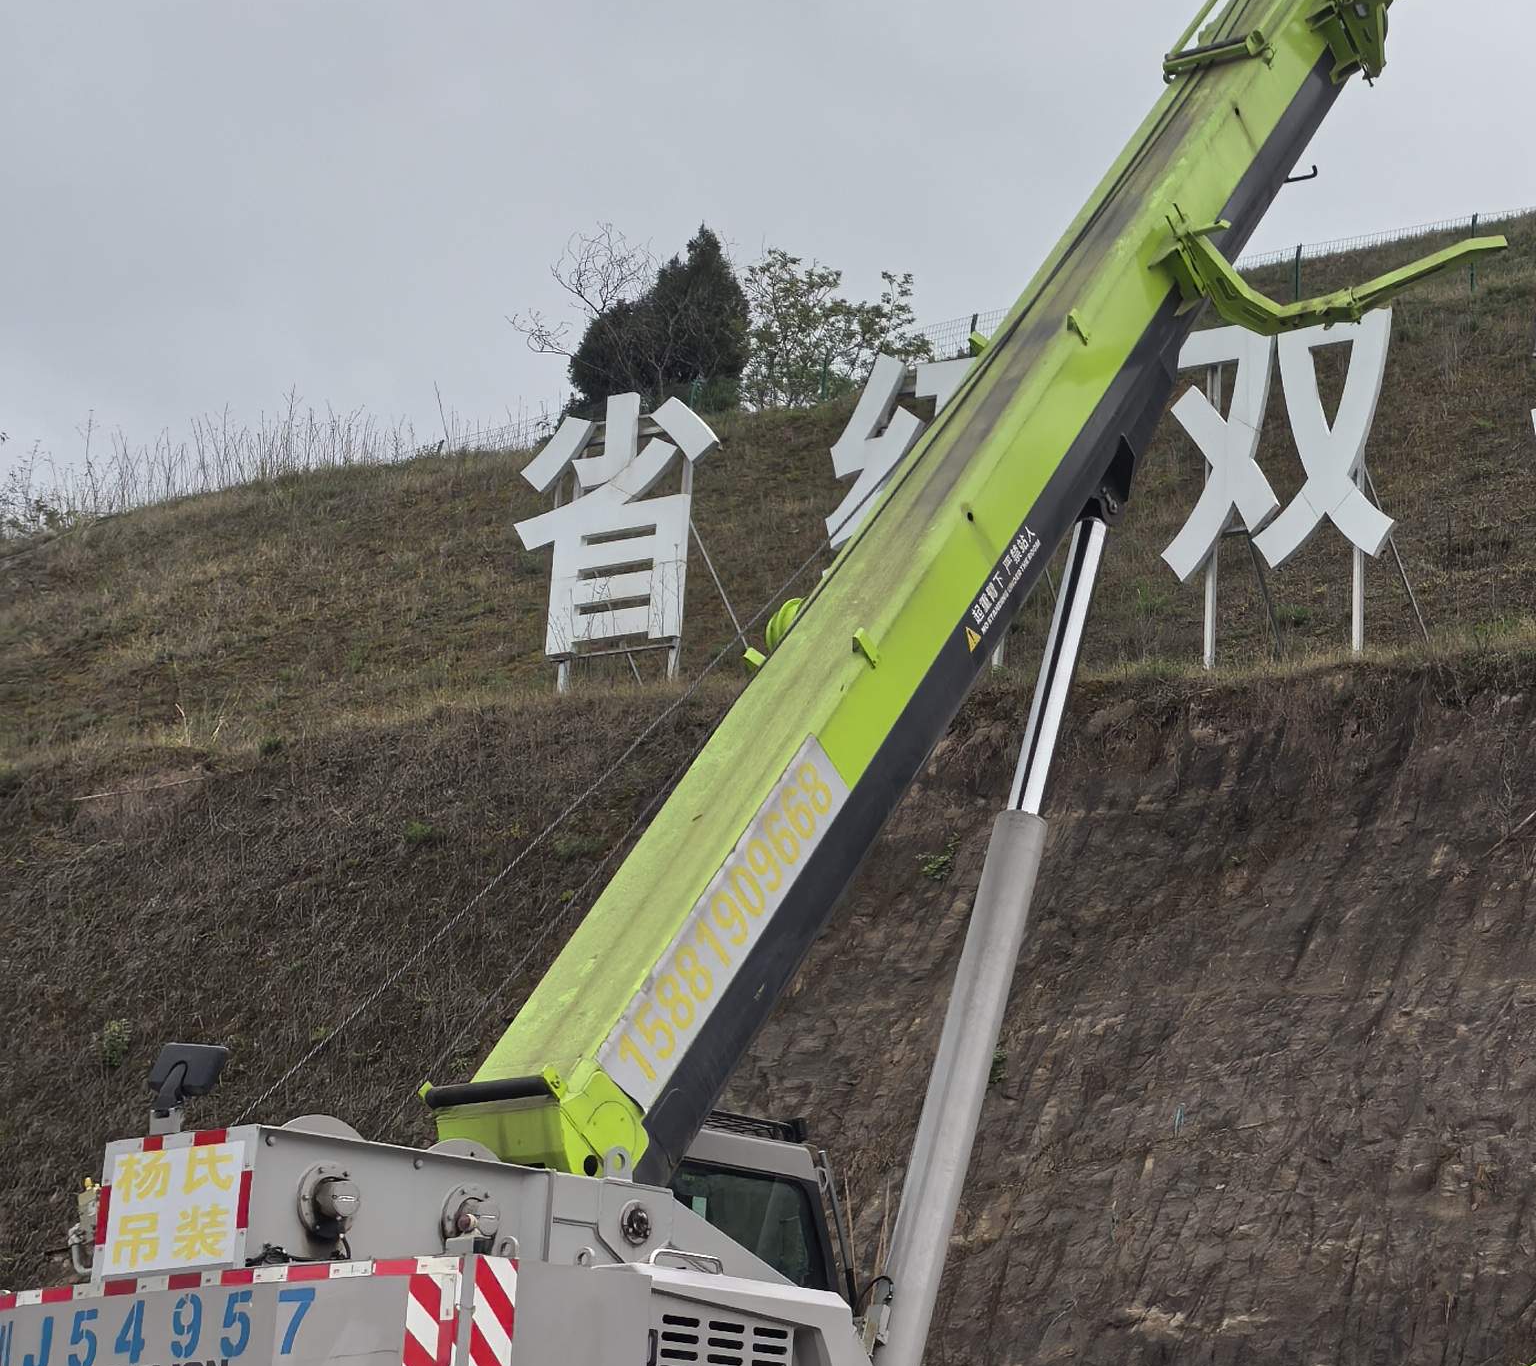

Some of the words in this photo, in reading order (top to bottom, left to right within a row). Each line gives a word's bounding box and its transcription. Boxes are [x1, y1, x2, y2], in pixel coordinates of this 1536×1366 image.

[617, 762, 833, 1080] 15881909668
[116, 1146, 234, 1203] 杨氏
[112, 1203, 230, 1268] 吊装
